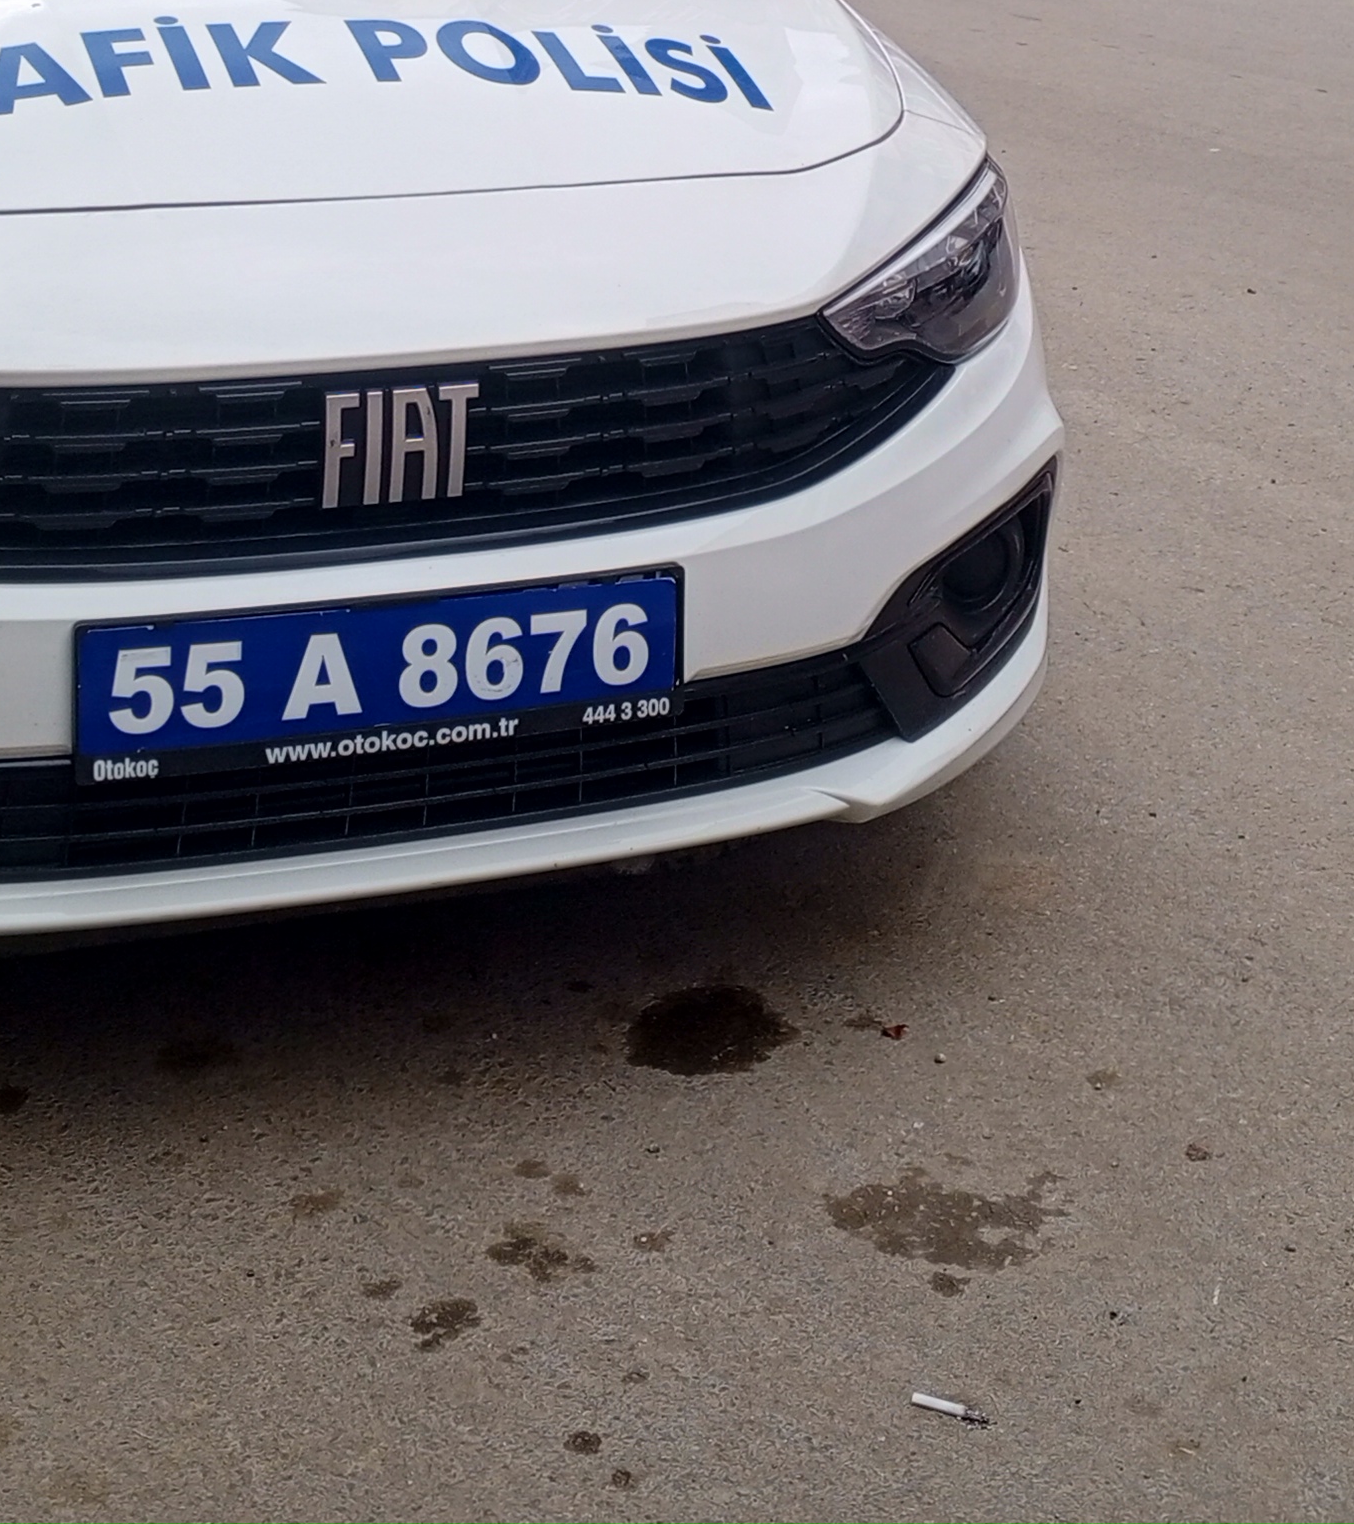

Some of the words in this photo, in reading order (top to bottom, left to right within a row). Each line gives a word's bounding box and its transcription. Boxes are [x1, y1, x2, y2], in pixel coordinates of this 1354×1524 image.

[343, 18, 776, 113] POLİSİ
[321, 381, 480, 510] FIAT
[108, 640, 246, 736] 55
[281, 632, 363, 722] A
[397, 602, 649, 710] 8676
[265, 716, 519, 766] www.otokoc.com.tr
[582, 702, 617, 726] 444
[620, 702, 633, 722] 3
[636, 697, 671, 720] 300
[93, 758, 159, 782] Otokoç
